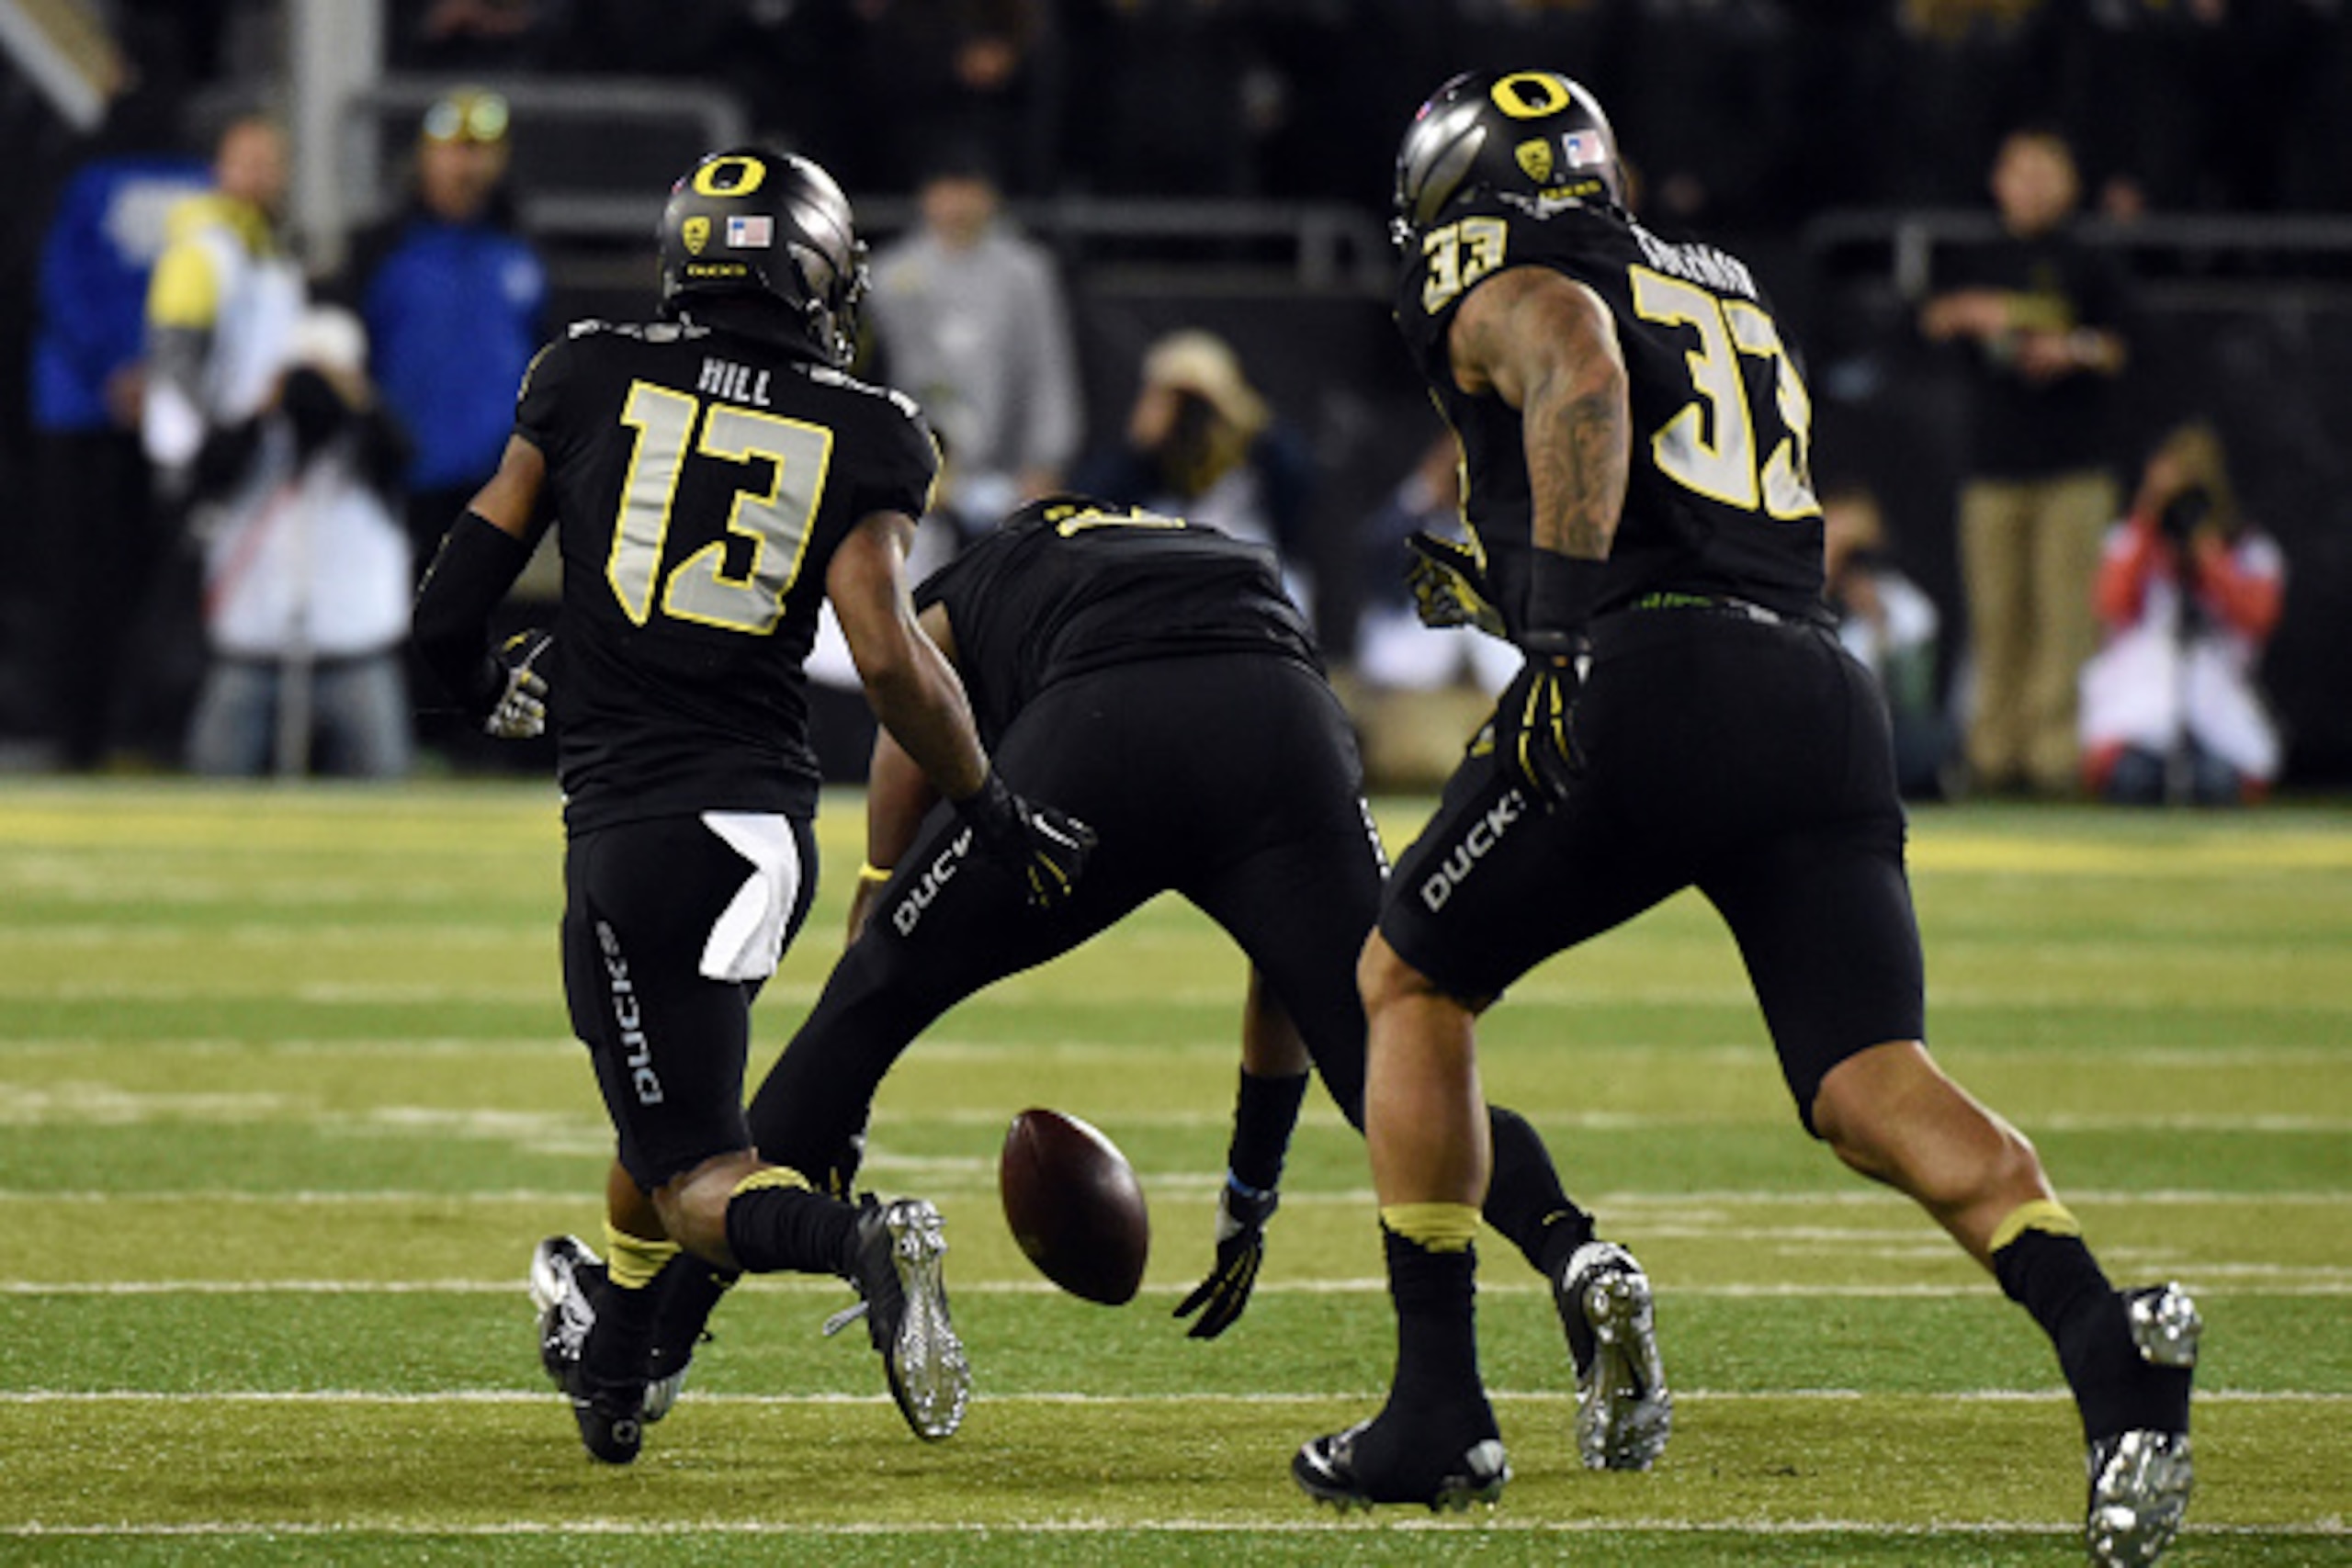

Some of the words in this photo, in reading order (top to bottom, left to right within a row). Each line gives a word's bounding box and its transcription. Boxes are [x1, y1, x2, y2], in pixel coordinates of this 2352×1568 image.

[1420, 216, 1509, 315] 33
[696, 356, 772, 407] HILL
[1628, 263, 1824, 521] 33
[605, 378, 833, 636] 13
[597, 919, 663, 1105] DUCKS
